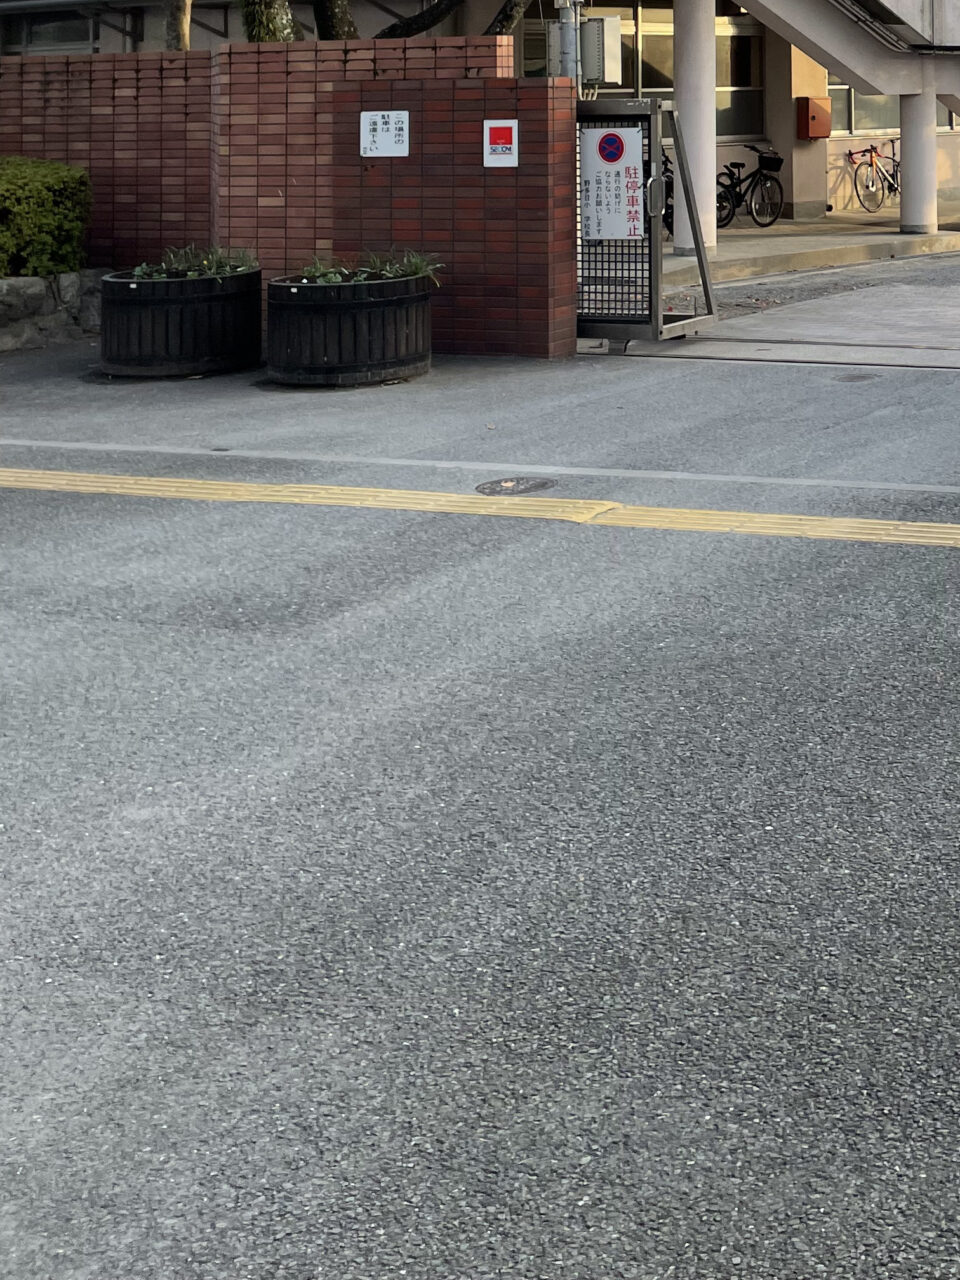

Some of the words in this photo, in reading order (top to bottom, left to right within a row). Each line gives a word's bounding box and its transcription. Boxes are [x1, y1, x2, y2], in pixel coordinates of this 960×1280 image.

[625, 166, 640, 237] 駐停車禁止
